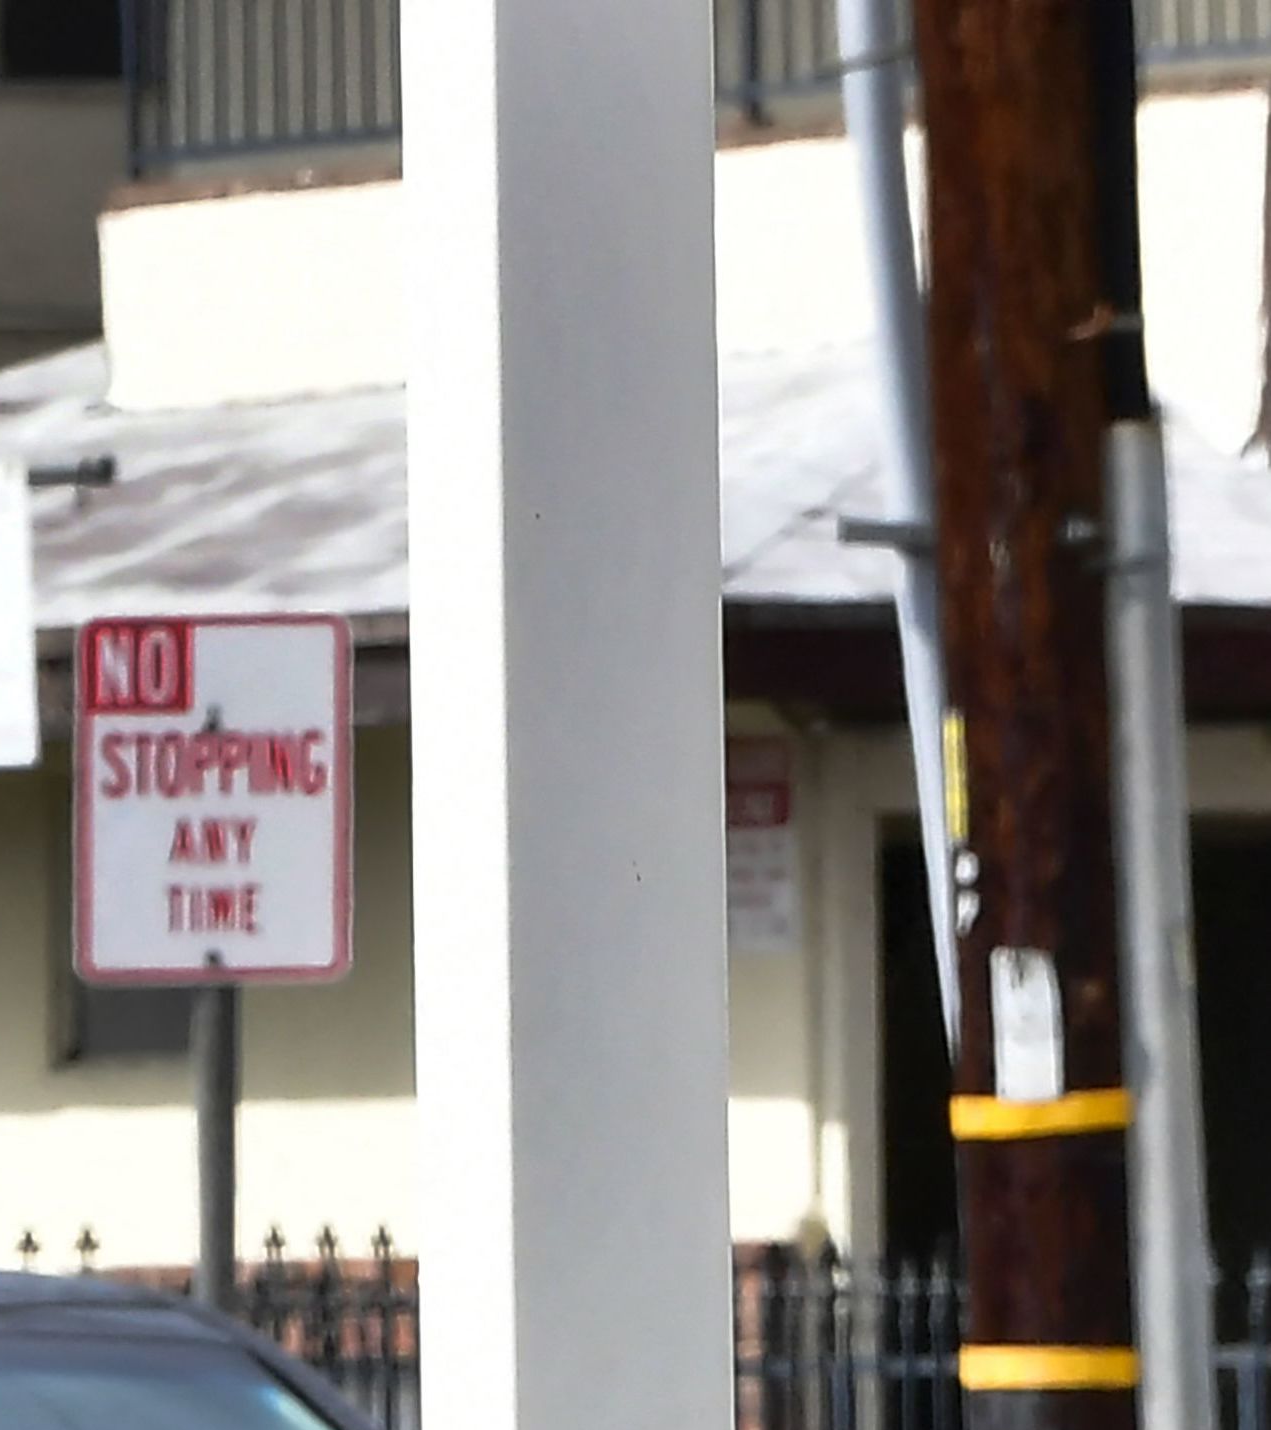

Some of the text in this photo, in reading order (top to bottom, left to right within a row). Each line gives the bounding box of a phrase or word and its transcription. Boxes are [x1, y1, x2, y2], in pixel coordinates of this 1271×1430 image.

[95, 623, 179, 708] NO
[99, 729, 328, 799] STOPPING
[167, 816, 259, 866] ANY
[167, 883, 263, 936] TIME
